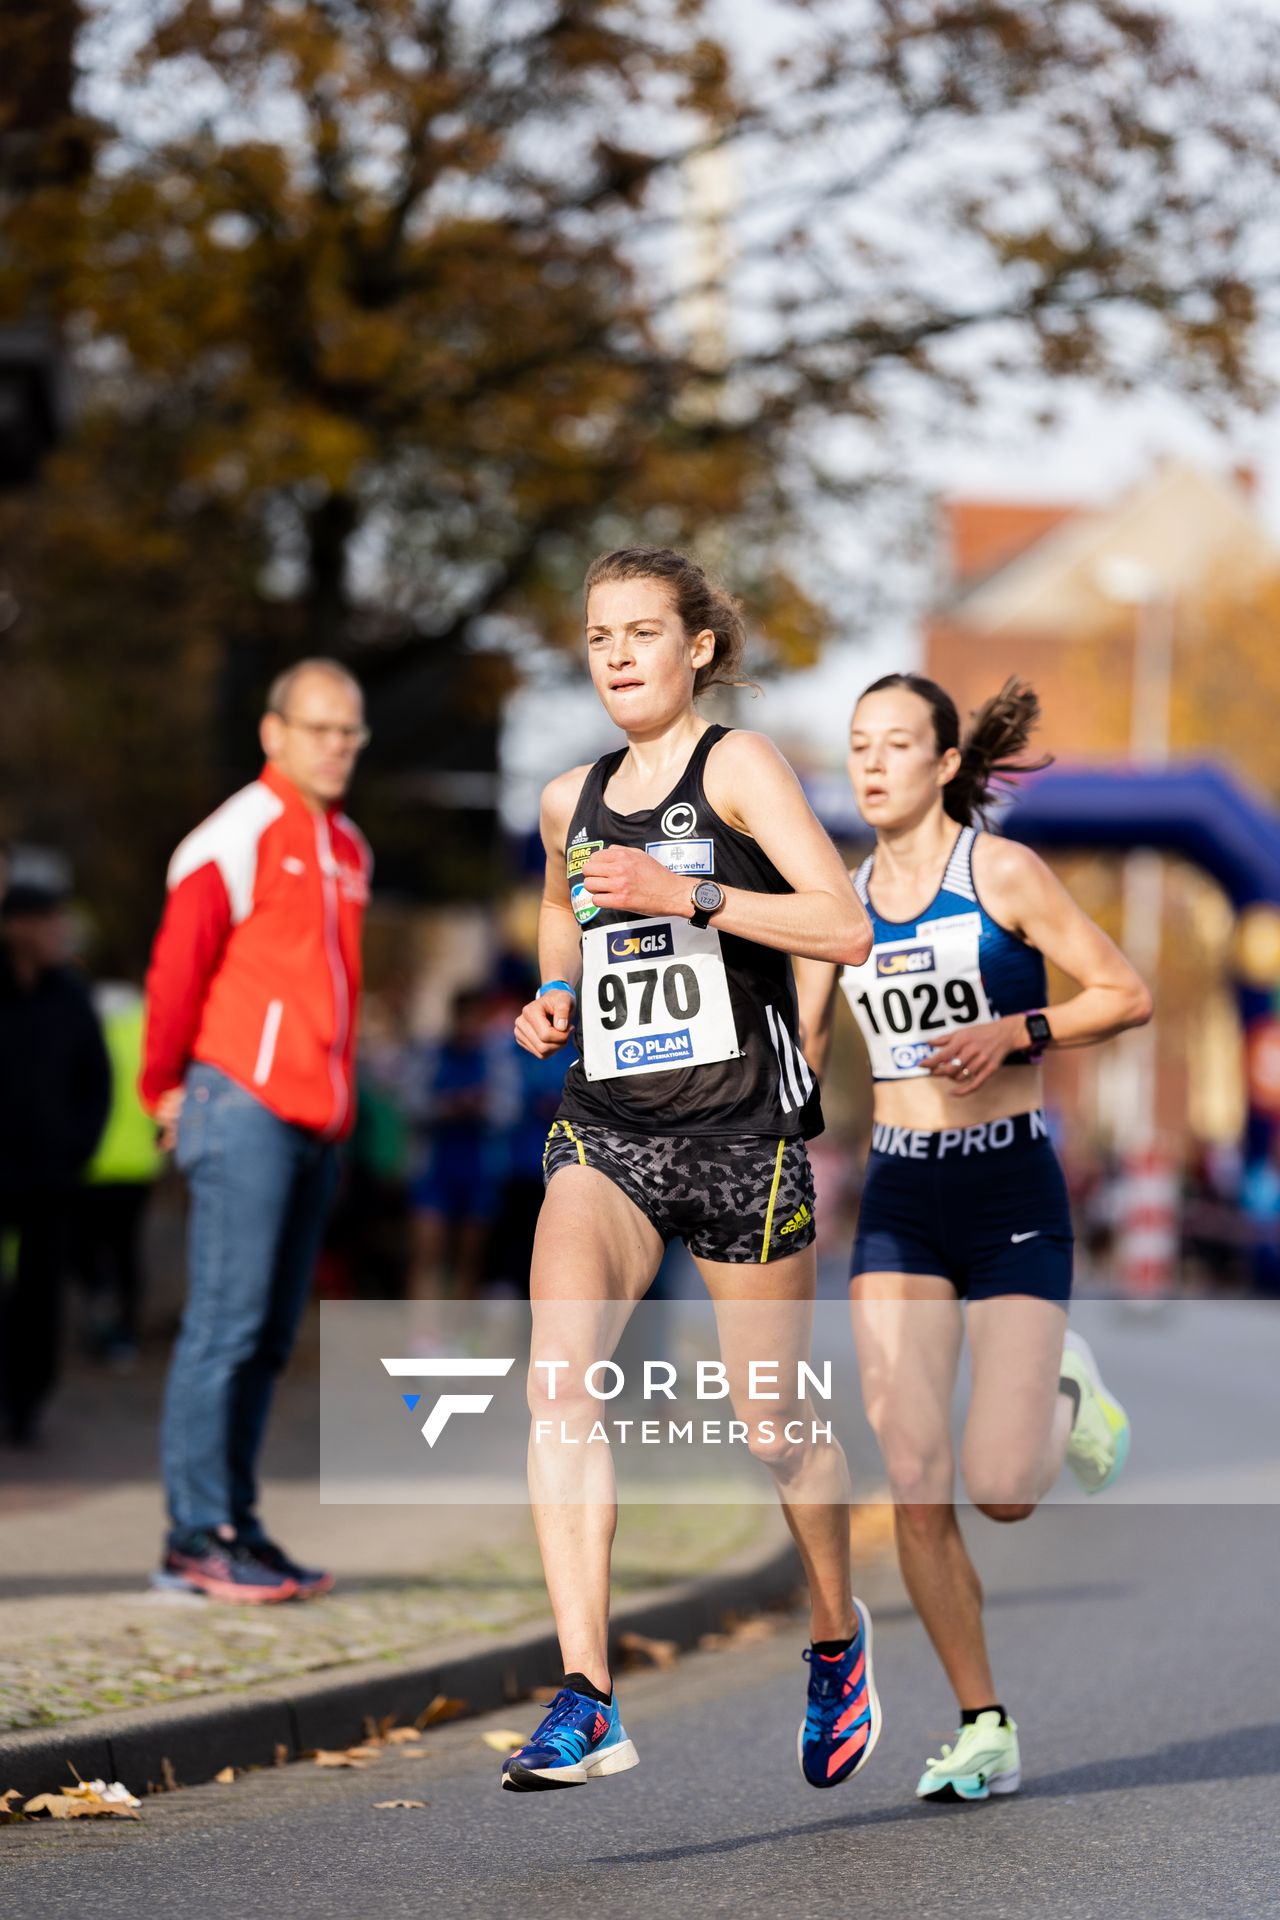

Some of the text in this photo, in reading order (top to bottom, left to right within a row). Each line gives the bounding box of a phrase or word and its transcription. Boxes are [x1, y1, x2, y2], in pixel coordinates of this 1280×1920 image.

[572, 846, 592, 859] BURG
[640, 934, 667, 952] GLS
[598, 964, 700, 1030] 970
[858, 979, 979, 1034] 1029
[645, 1035, 689, 1054] PLAN
[647, 1049, 690, 1061] INTERNATIONAL
[937, 1118, 1014, 1160] PRO
[780, 1214, 811, 1235] adidas
